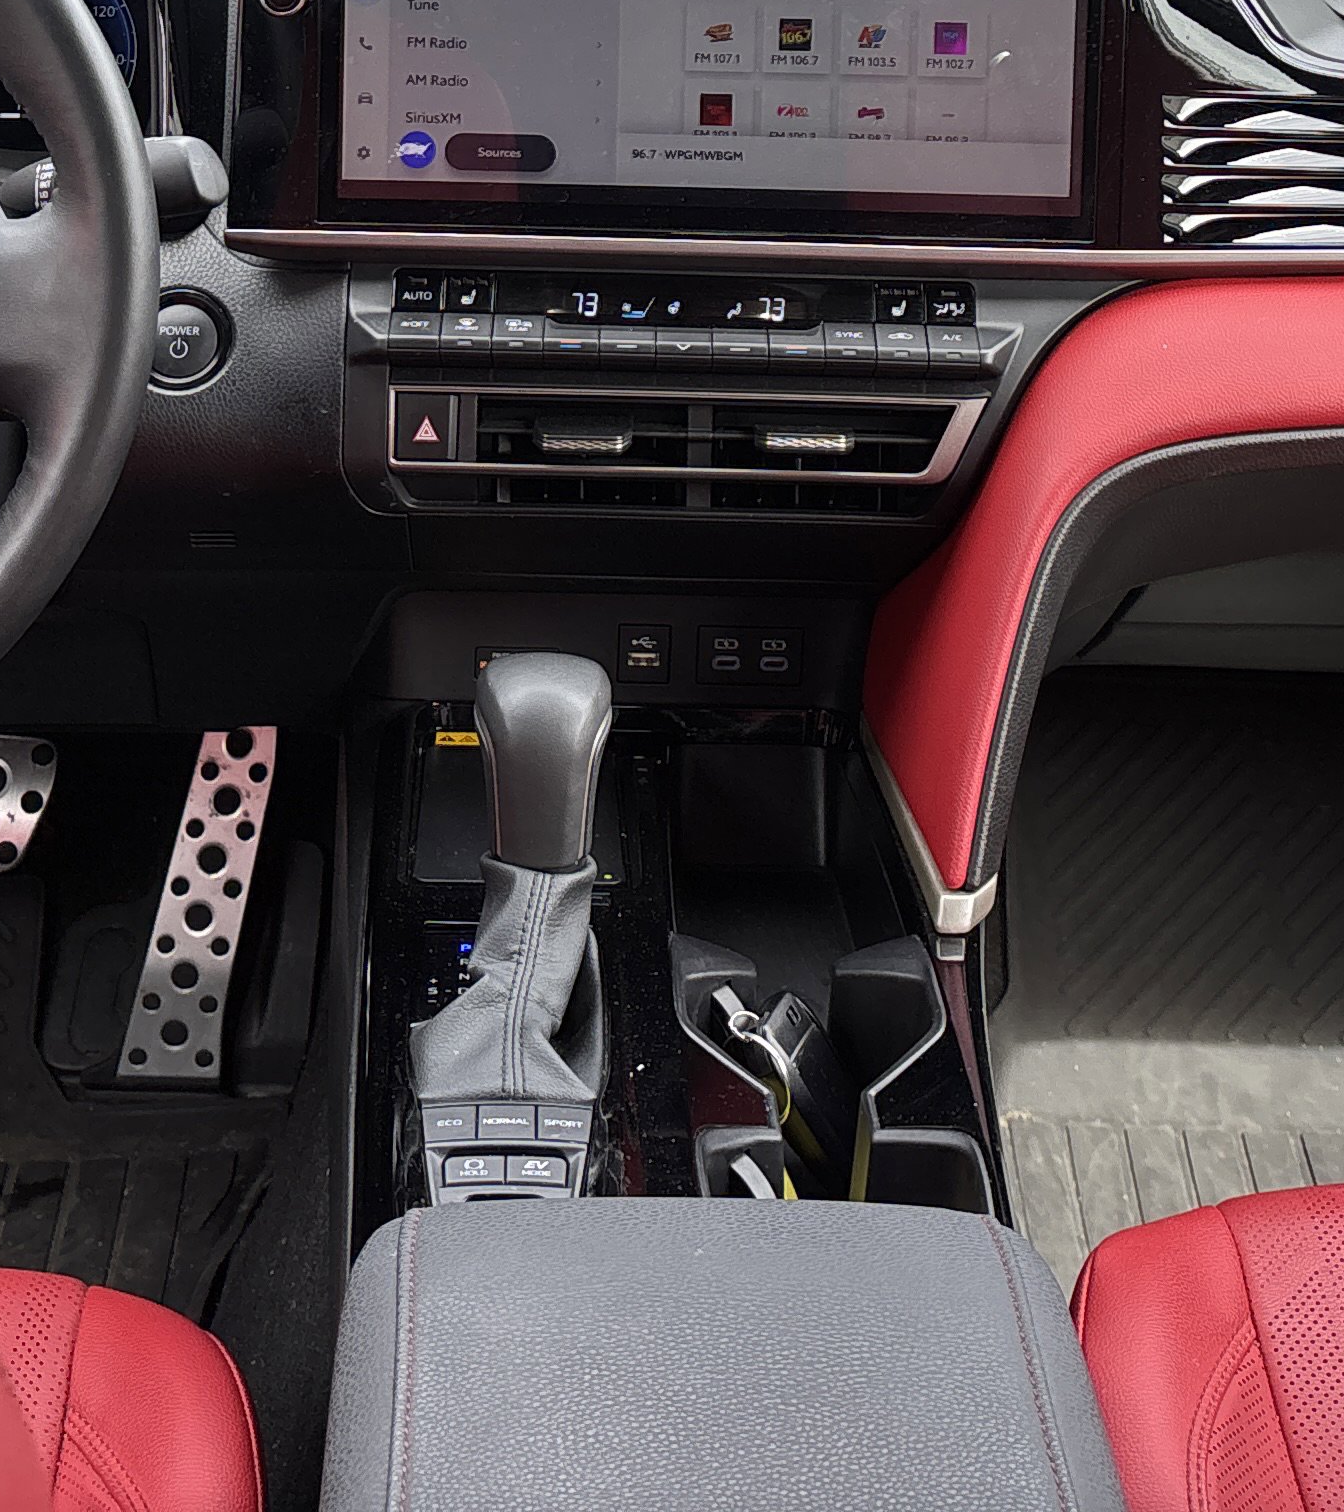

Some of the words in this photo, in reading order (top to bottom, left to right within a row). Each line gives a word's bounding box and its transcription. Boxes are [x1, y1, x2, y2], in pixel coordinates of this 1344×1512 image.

[93, 5, 116, 17] 120
[408, 0, 440, 11] Tune
[407, 37, 426, 49] FM
[429, 37, 467, 50] Radio
[694, 53, 711, 63] FM
[771, 55, 786, 65] FM
[787, 55, 819, 65] 106.7
[848, 57, 866, 67] FM
[868, 57, 897, 68] 103.5
[926, 59, 943, 69] FM
[946, 59, 974, 70] 102.7
[405, 75, 427, 87] AM
[430, 75, 469, 87] Radio
[405, 111, 462, 125] SiriusXM
[477, 147, 522, 159] Sources
[632, 148, 657, 160] 96.7
[664, 150, 744, 162] WPGMWBGM
[403, 291, 433, 301] AUTO
[572, 292, 599, 316] 73
[159, 326, 200, 336] POWER
[942, 334, 962, 342] A/C
[437, 1119, 463, 1127] ECO
[483, 1118, 529, 1126] NORMAL
[544, 1119, 584, 1129] SPORT
[524, 1160, 549, 1169] EV
